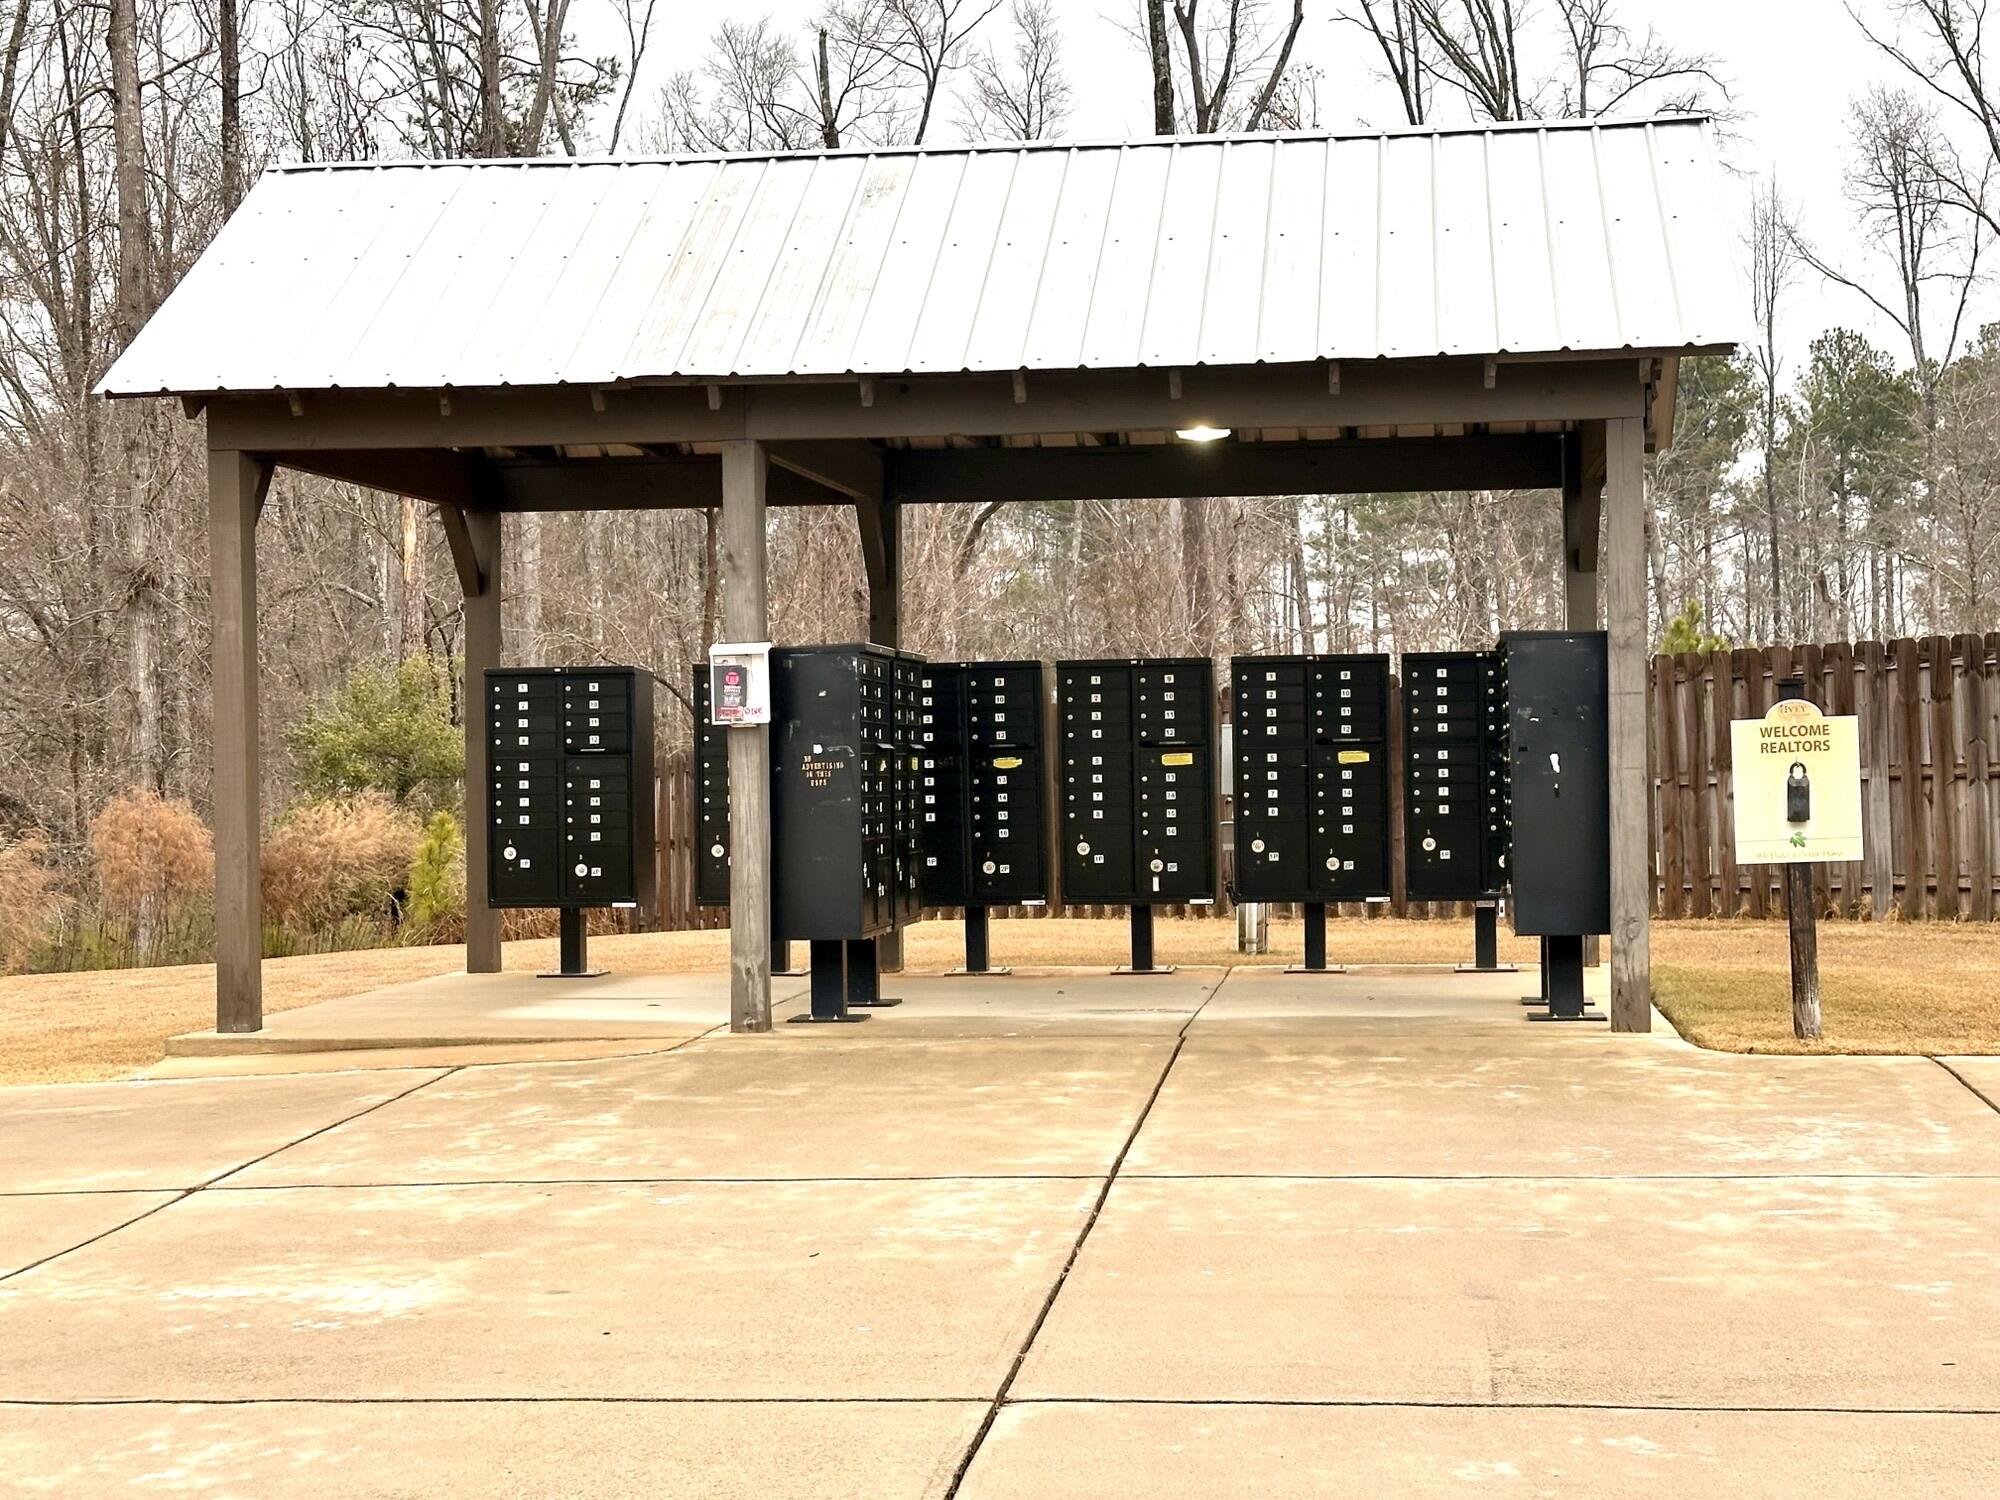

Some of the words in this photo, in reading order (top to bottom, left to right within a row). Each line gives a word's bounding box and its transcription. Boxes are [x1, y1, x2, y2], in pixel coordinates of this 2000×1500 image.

[1342, 689, 1350, 697] 10
[1342, 707, 1350, 715] 11
[1760, 725, 1830, 738] WELCOME
[1760, 740, 1831, 754] REALTORS
[802, 762, 844, 770] ADVERTISING
[816, 770, 831, 778] THIS
[1000, 865, 1009, 873] 2P
